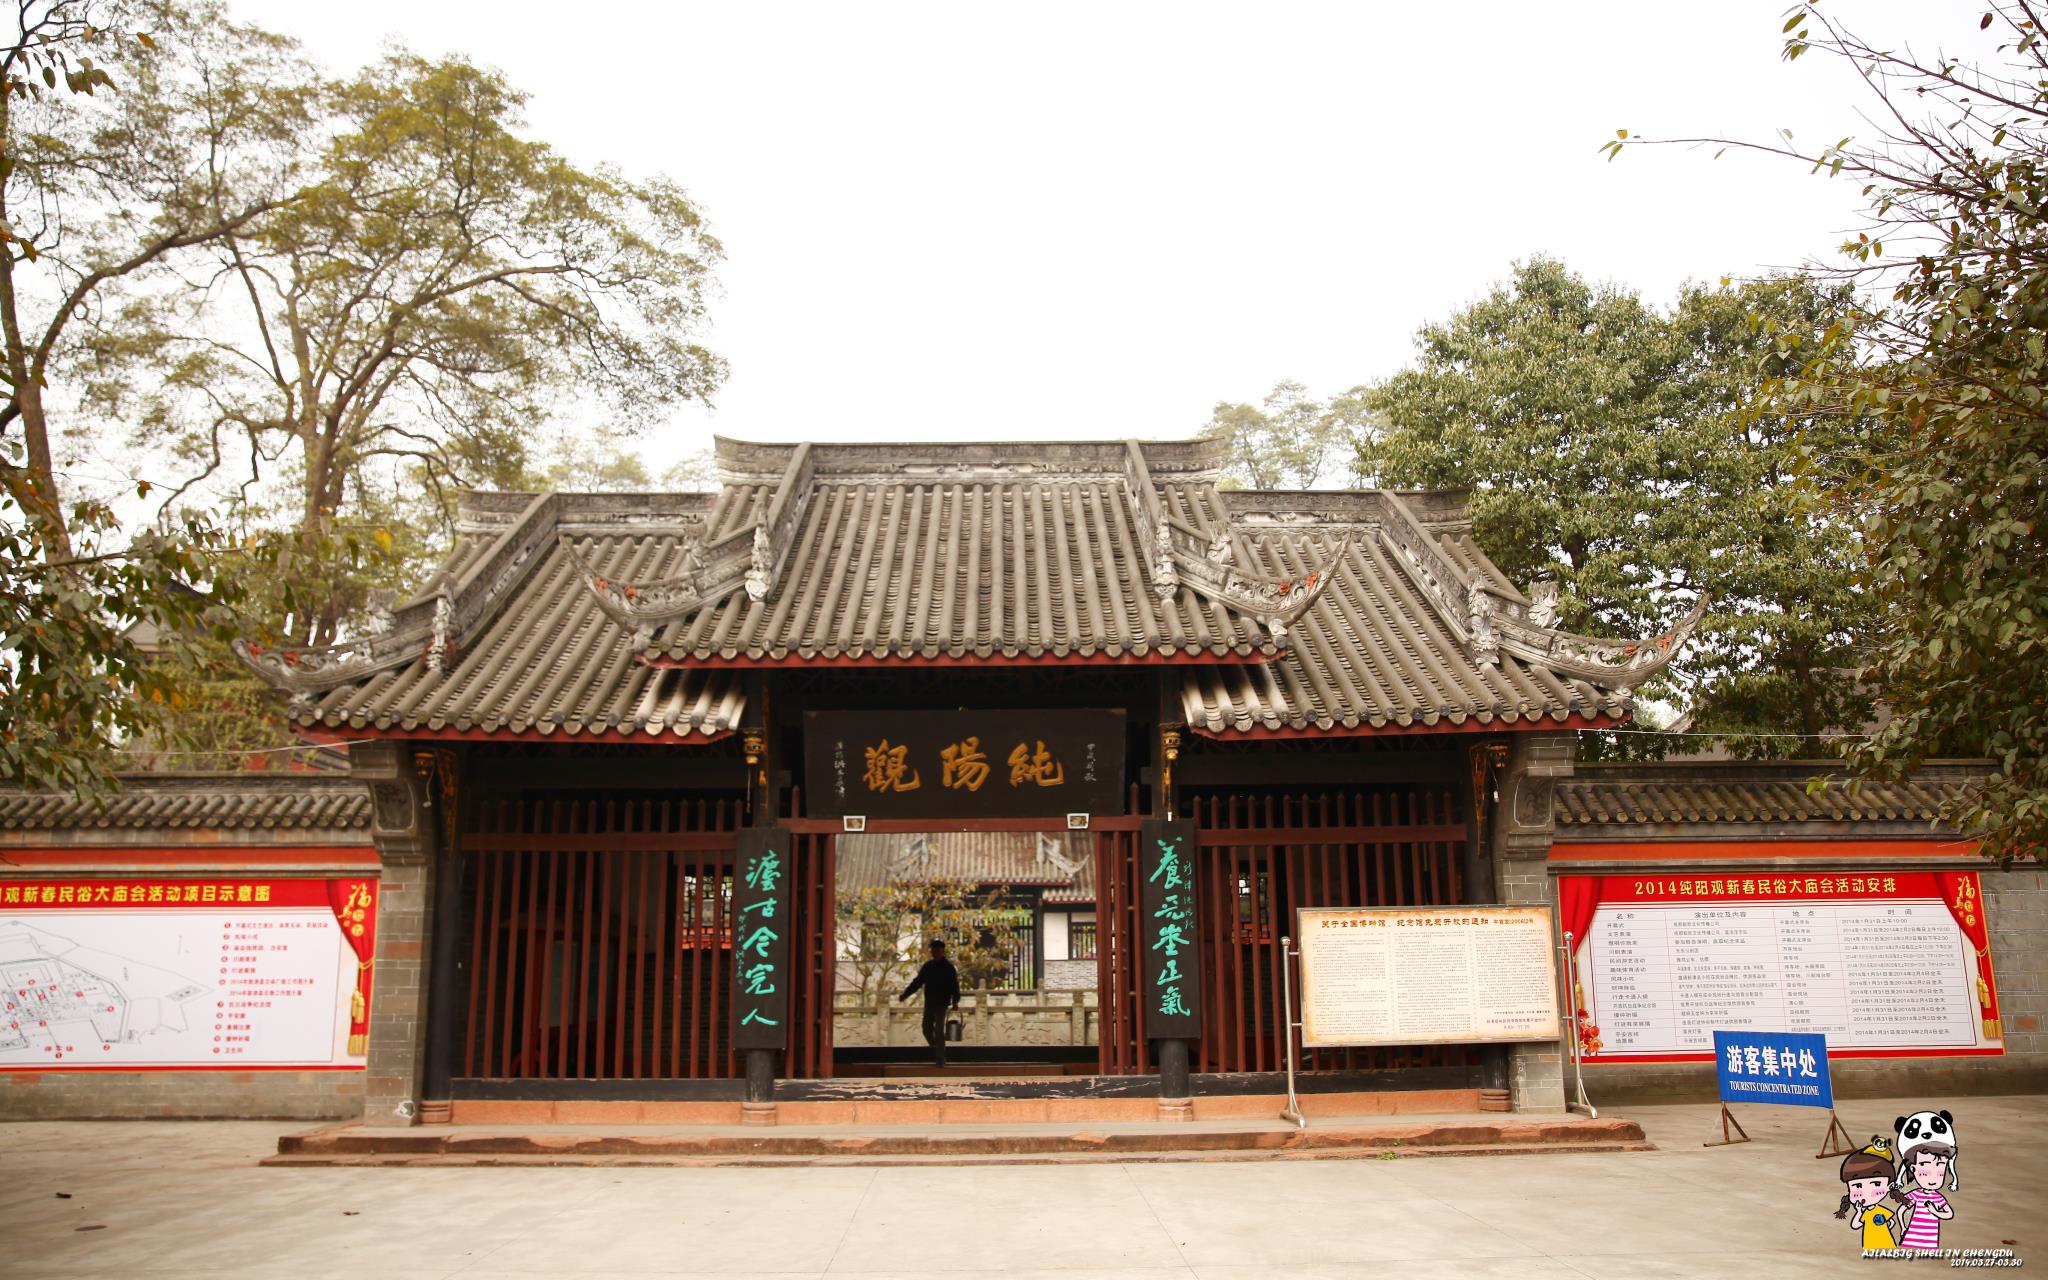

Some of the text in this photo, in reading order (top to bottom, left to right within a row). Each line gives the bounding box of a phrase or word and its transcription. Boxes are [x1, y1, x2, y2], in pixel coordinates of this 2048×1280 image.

[1634, 877, 1897, 896] 2014纯阳观新春民俗大庙会活动安排
[1726, 1044, 1818, 1078] 游客集中处
[1729, 1080, 1820, 1096] TOURISTS CONCENTRATED ZONE
